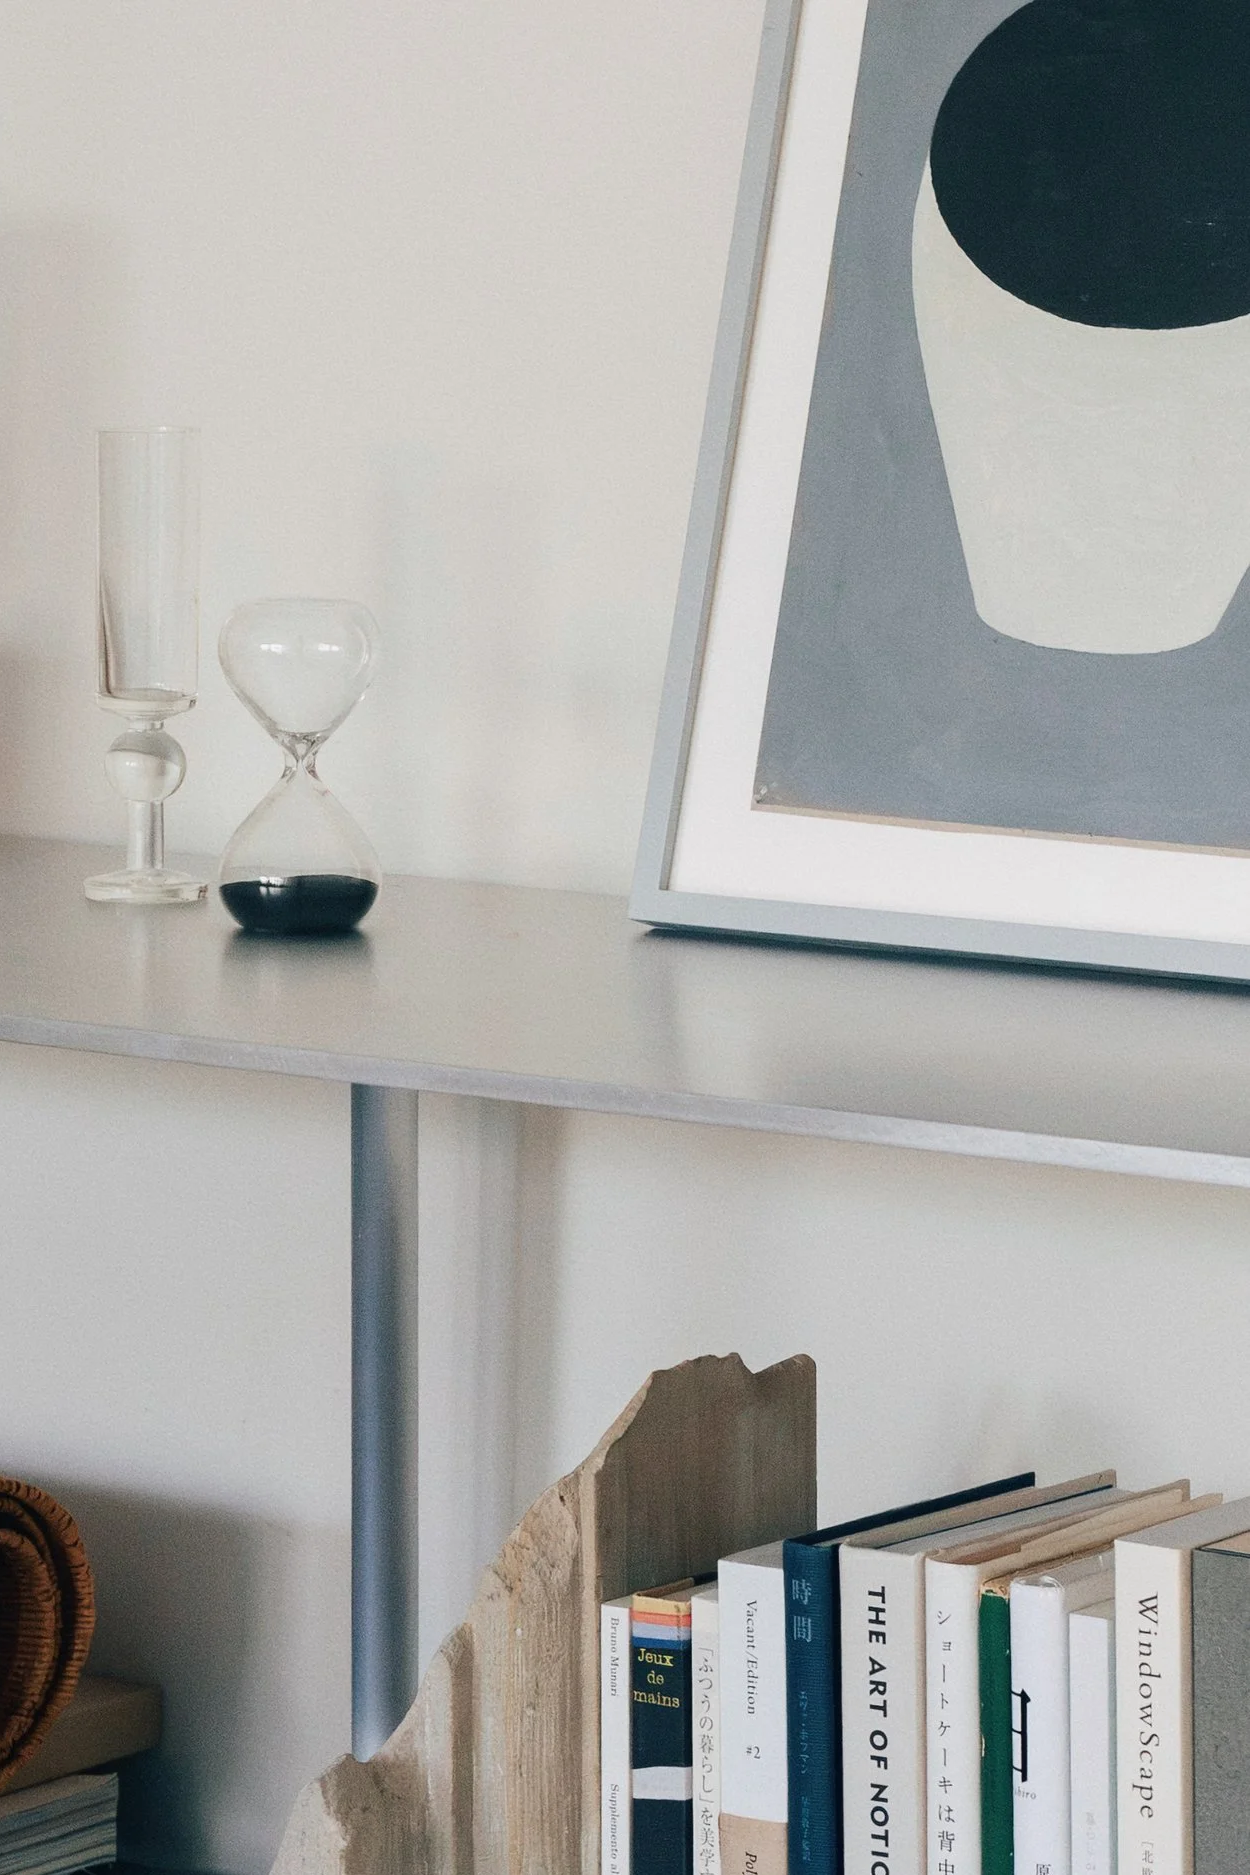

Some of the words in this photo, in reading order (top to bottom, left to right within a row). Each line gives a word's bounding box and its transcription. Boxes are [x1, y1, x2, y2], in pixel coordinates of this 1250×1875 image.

[792, 1579, 812, 1643] 時間
[868, 1586, 887, 1645] THE
[610, 1616, 620, 1650] Bruno
[610, 1654, 620, 1696] Munari
[638, 1647, 674, 1668] Jeux
[646, 1669, 665, 1684] de
[633, 1690, 680, 1708] mains
[869, 1656, 888, 1718] ART
[1132, 1592, 1160, 1820] WindowScape
[746, 1745, 761, 1759] #2
[869, 1729, 888, 1770] OF
[608, 1783, 620, 1859] Supplemento
[610, 1863, 621, 1875] al
